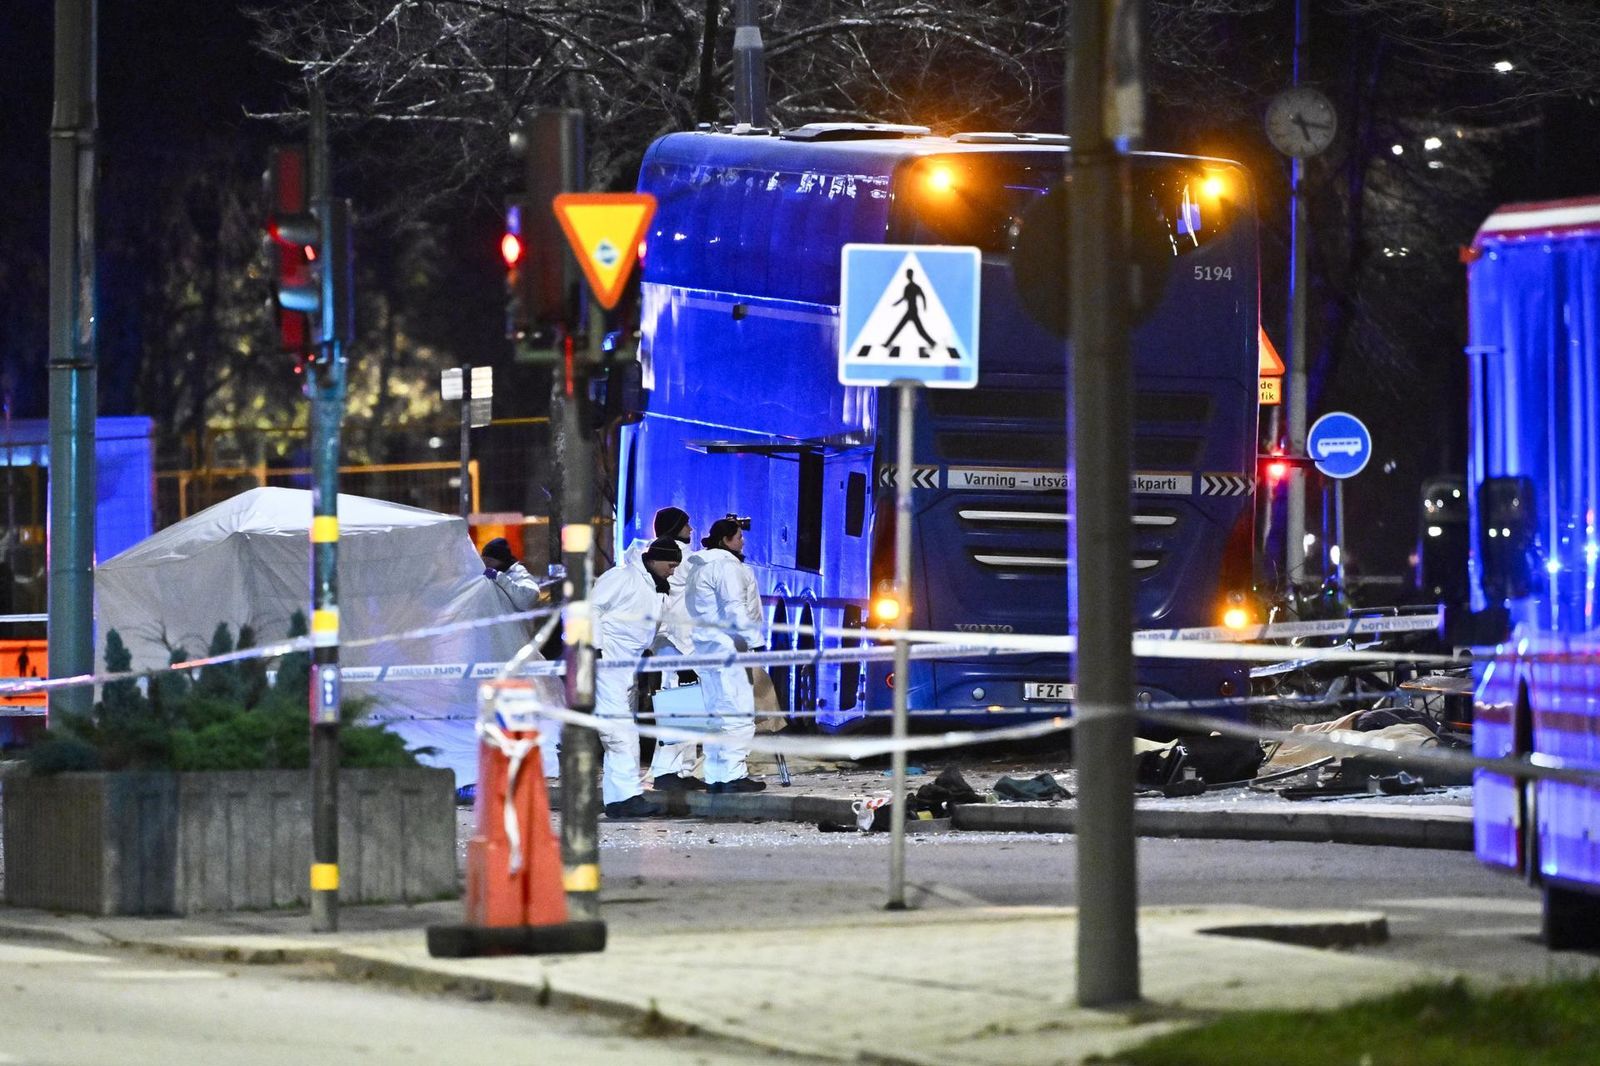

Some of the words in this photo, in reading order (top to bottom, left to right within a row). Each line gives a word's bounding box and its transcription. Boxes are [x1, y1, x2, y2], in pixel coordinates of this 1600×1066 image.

[1193, 265, 1232, 281] 5194
[1260, 381, 1273, 390] de
[1260, 391, 1274, 401] fik
[964, 472, 1016, 489] Varning
[1033, 475, 1070, 488] utsvä
[1131, 477, 1177, 492] akparti
[1036, 684, 1064, 698] FZF
